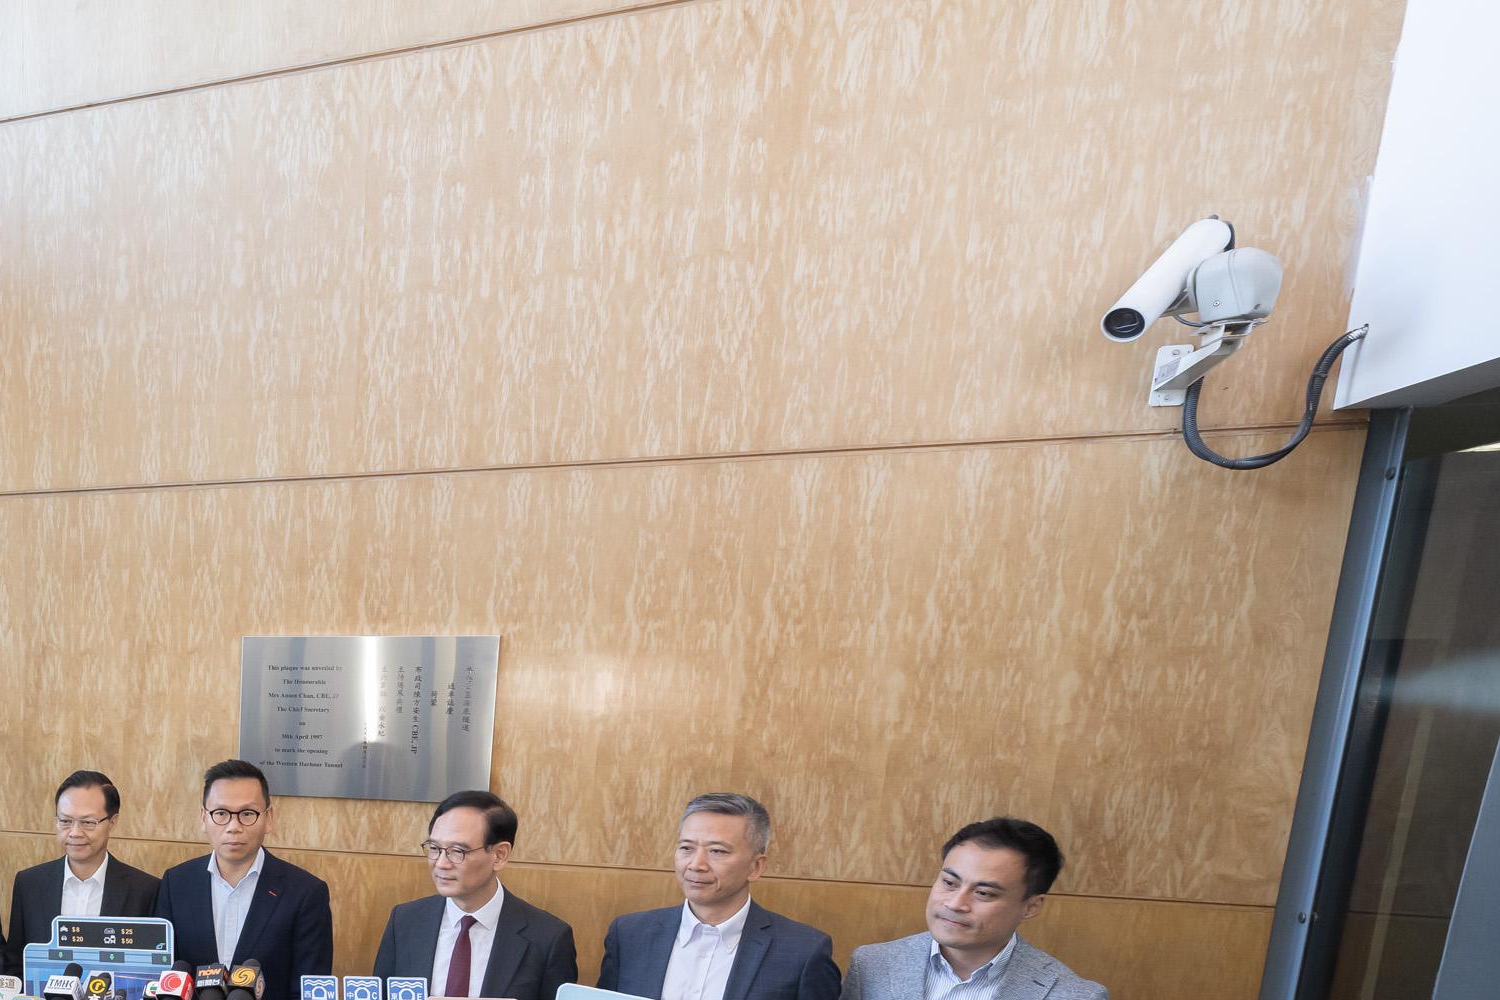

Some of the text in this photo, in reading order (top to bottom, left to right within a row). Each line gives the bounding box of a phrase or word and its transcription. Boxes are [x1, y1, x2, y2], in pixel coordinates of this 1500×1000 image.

[198, 967, 222, 977] now
[327, 991, 335, 999] W
[346, 992, 378, 1000] 中 C
[416, 993, 423, 1000] E
